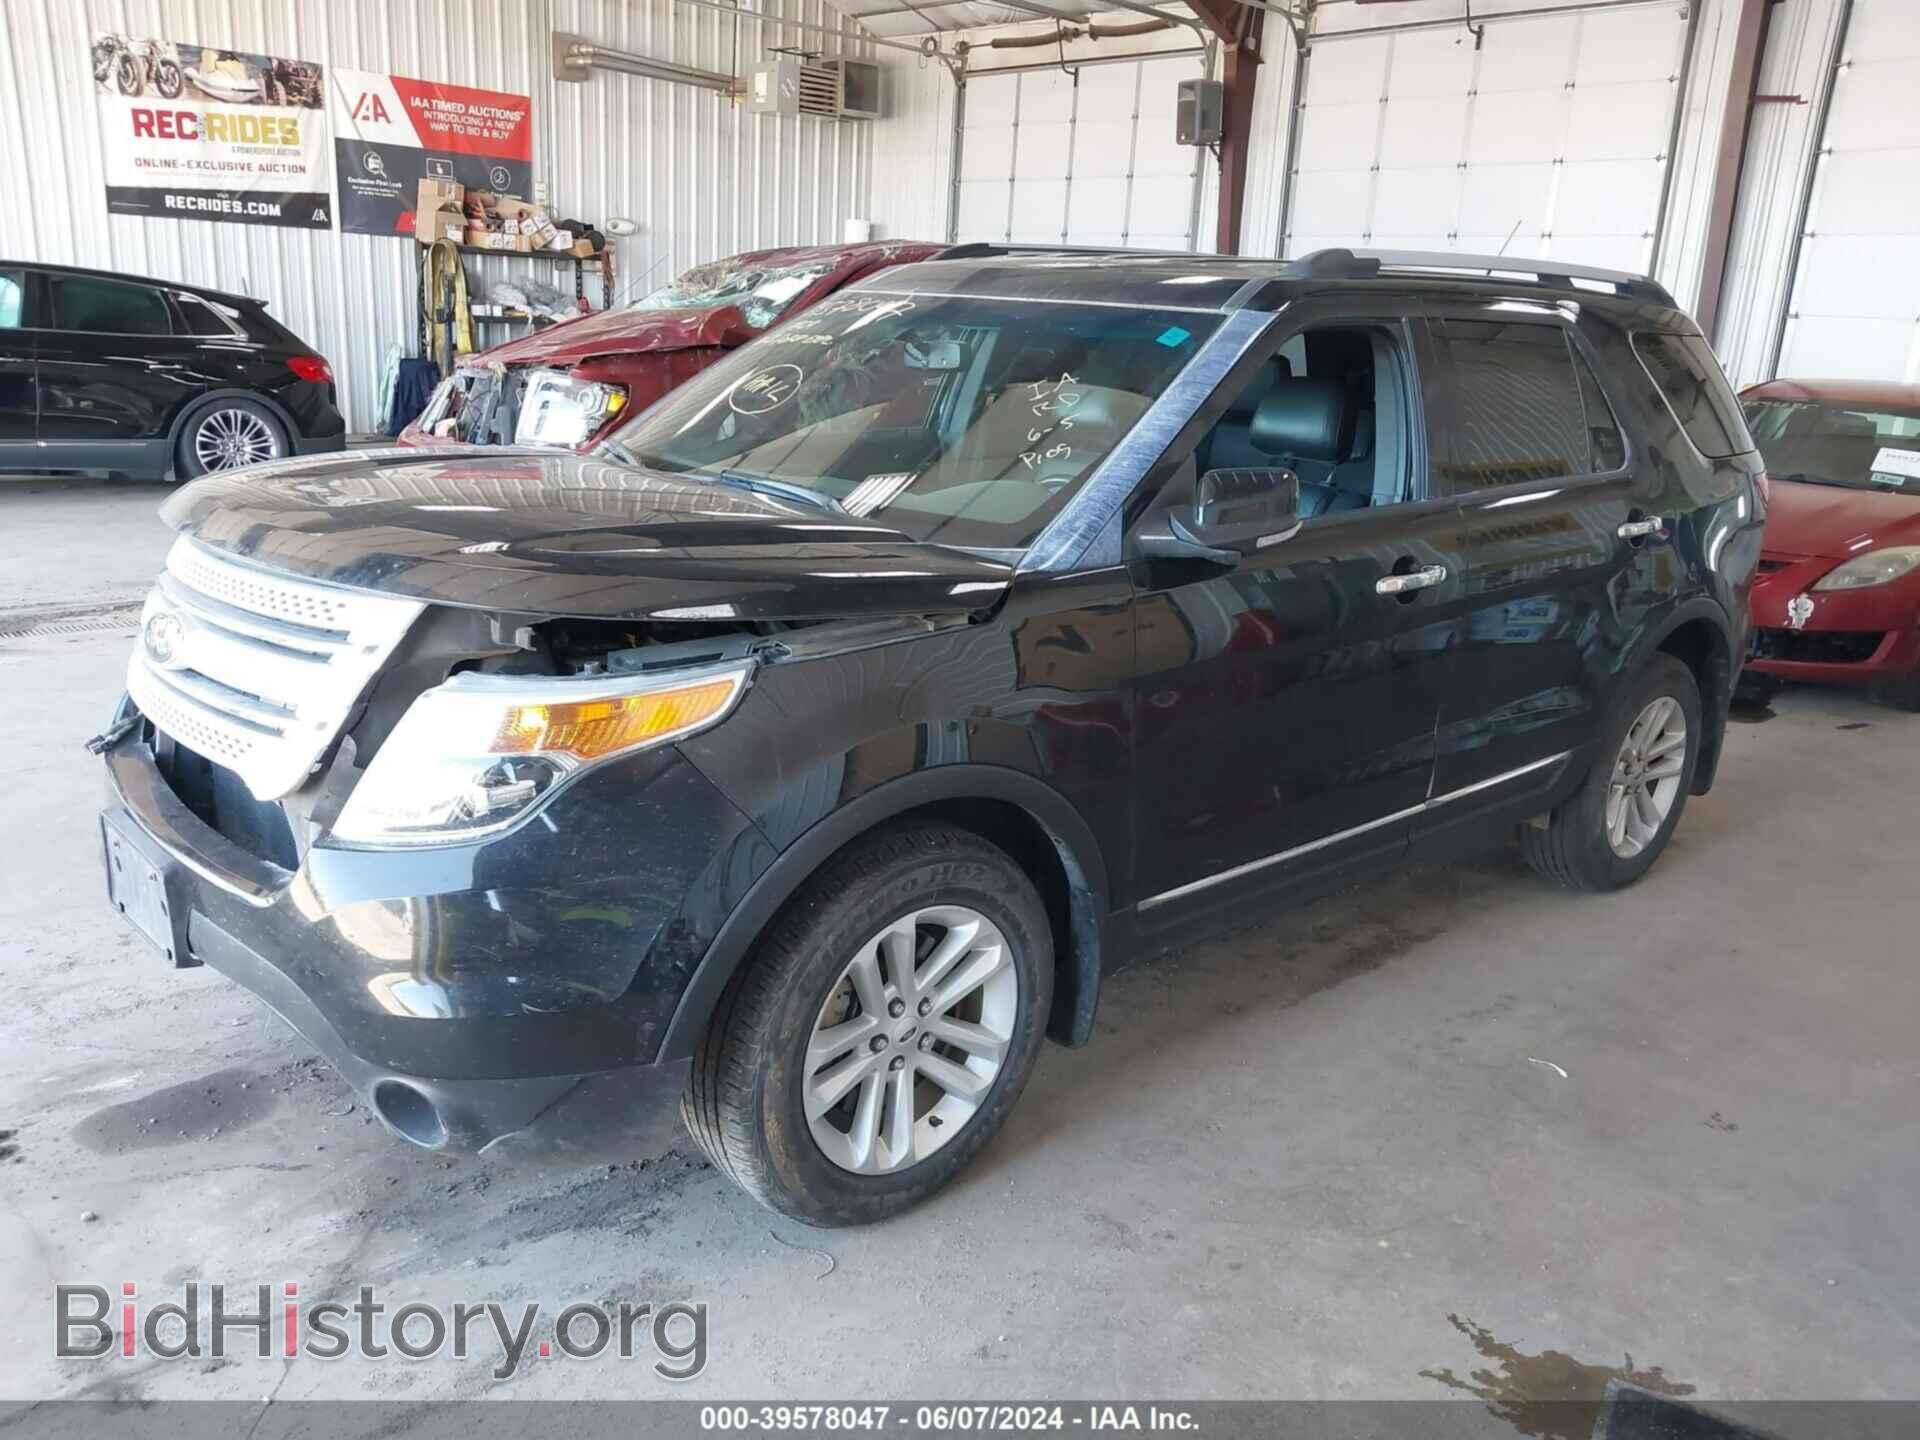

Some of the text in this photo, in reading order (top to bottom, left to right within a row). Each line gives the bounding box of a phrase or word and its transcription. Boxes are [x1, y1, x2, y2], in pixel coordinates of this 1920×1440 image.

[410, 95, 429, 109] IAA
[430, 98, 465, 114] TIMED
[131, 108, 300, 145] REC RIDES
[423, 110, 516, 131] INTRODUCING A NEW
[430, 121, 510, 141] WAY TO BID & BUY
[135, 157, 306, 175] ONLINE-EXCLUSIVE AUCTION
[164, 194, 281, 217] RECRIDES.COM
